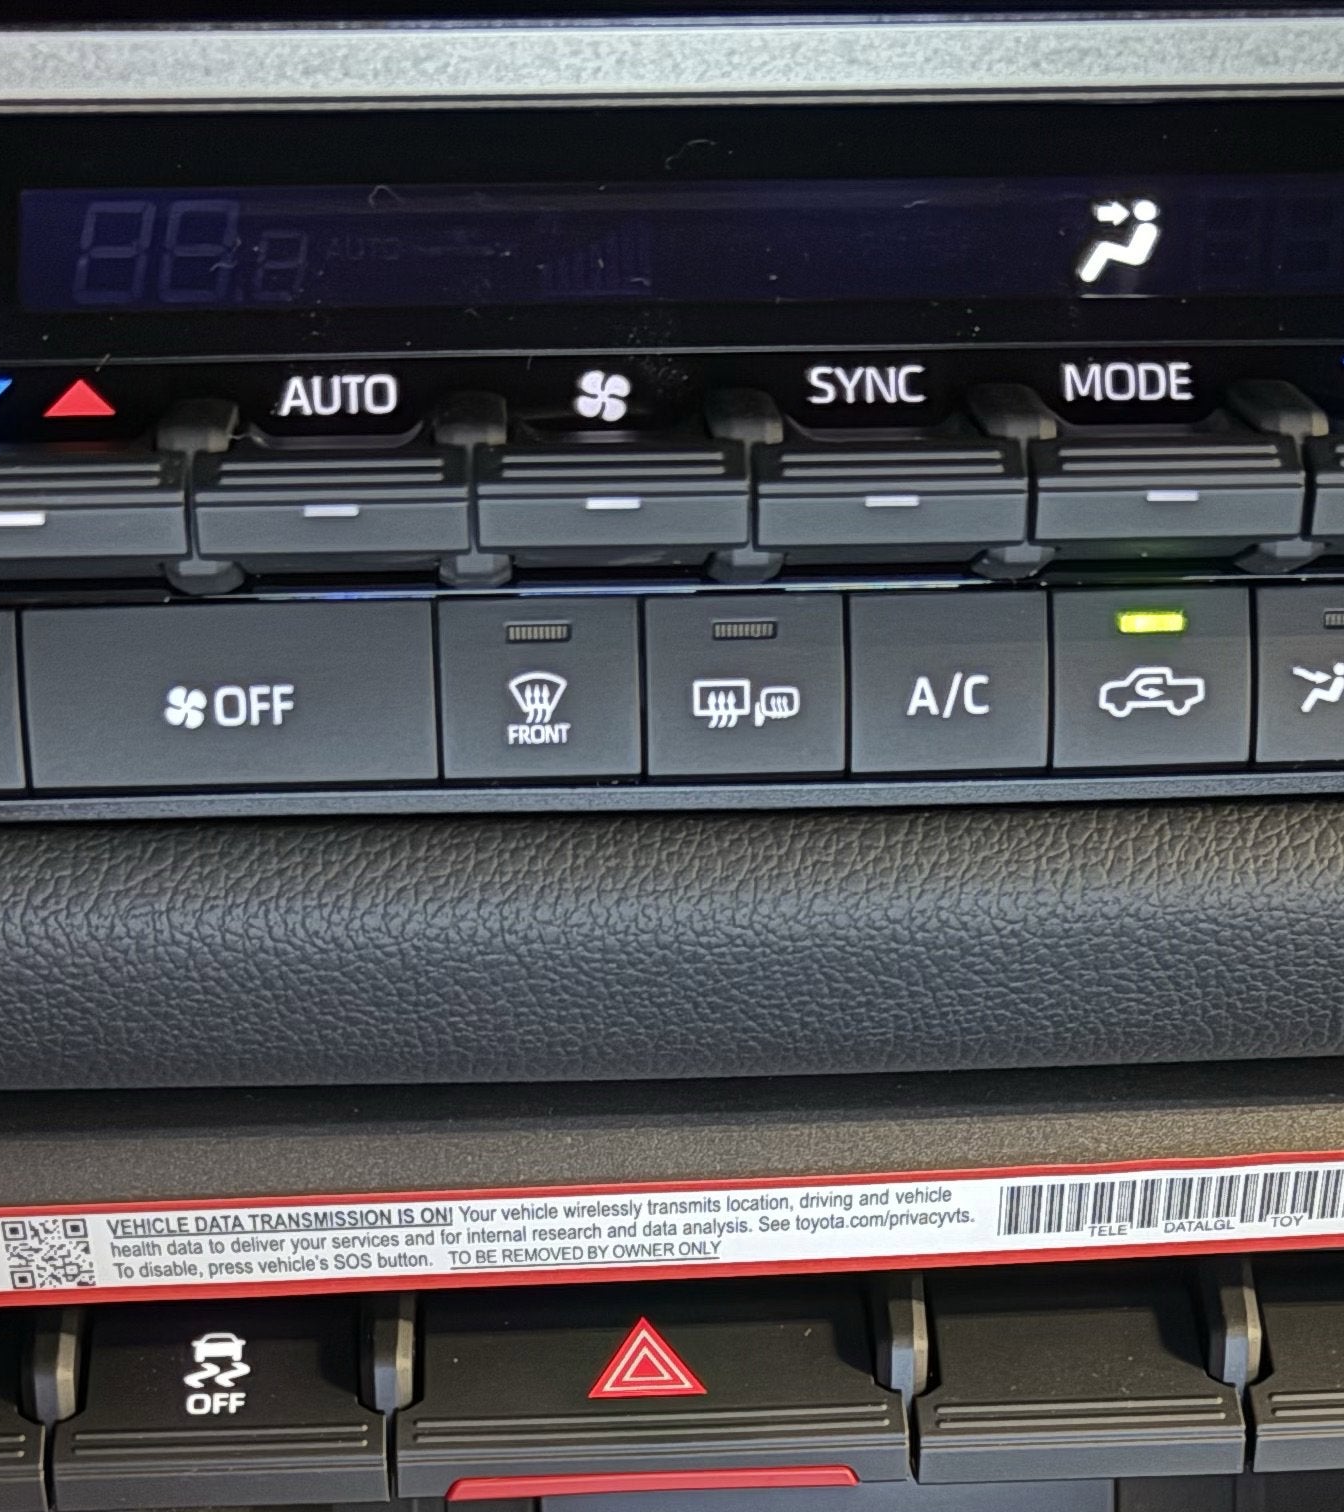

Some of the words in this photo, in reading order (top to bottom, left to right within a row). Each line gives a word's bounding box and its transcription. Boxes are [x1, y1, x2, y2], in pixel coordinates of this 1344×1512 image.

[278, 372, 398, 418] AUTO
[805, 364, 926, 404] SYNC
[1063, 361, 1195, 401] MODE
[214, 683, 295, 727] OFF
[906, 671, 990, 719] A/C
[507, 723, 571, 745] FRONT
[106, 1216, 190, 1236] VEHICLE
[194, 1214, 245, 1233] DATA
[248, 1208, 393, 1231] TRANSMISSION
[397, 1207, 416, 1226] IS
[458, 1204, 497, 1223] Your
[501, 1202, 559, 1221] vehicle
[563, 1198, 642, 1220] wirelessly
[648, 1196, 722, 1216] transmits
[726, 1194, 795, 1212] location,
[799, 1190, 854, 1211] driving
[858, 1188, 890, 1206] and
[895, 1186, 953, 1205] vehicle
[1088, 1224, 1128, 1238] TELE
[1163, 1218, 1236, 1235] DATALGL
[1270, 1214, 1305, 1229] TOY
[110, 1240, 163, 1258] health
[166, 1239, 204, 1256] data
[208, 1238, 226, 1254] to
[230, 1236, 286, 1253] deliver
[290, 1236, 328, 1255] your
[331, 1231, 400, 1249] services
[404, 1229, 435, 1247] and
[440, 1228, 463, 1245] for
[466, 1226, 527, 1244] internal
[532, 1222, 602, 1242] research
[606, 1220, 638, 1238] and
[642, 1219, 678, 1237] data
[682, 1216, 753, 1238] analysis.
[758, 1215, 791, 1233] See
[112, 1262, 135, 1280] To
[138, 1260, 204, 1279] disable,
[207, 1260, 254, 1279] press
[257, 1254, 330, 1274] vehicle's
[333, 1252, 373, 1271] SOS
[377, 1251, 434, 1269] button.
[448, 1250, 472, 1267] TO
[475, 1249, 498, 1266] BE
[501, 1246, 584, 1264] REMOVED
[587, 1244, 610, 1260] BY
[612, 1242, 675, 1259] OWNER
[678, 1240, 722, 1256] ONLY
[185, 1392, 247, 1416] OFF
